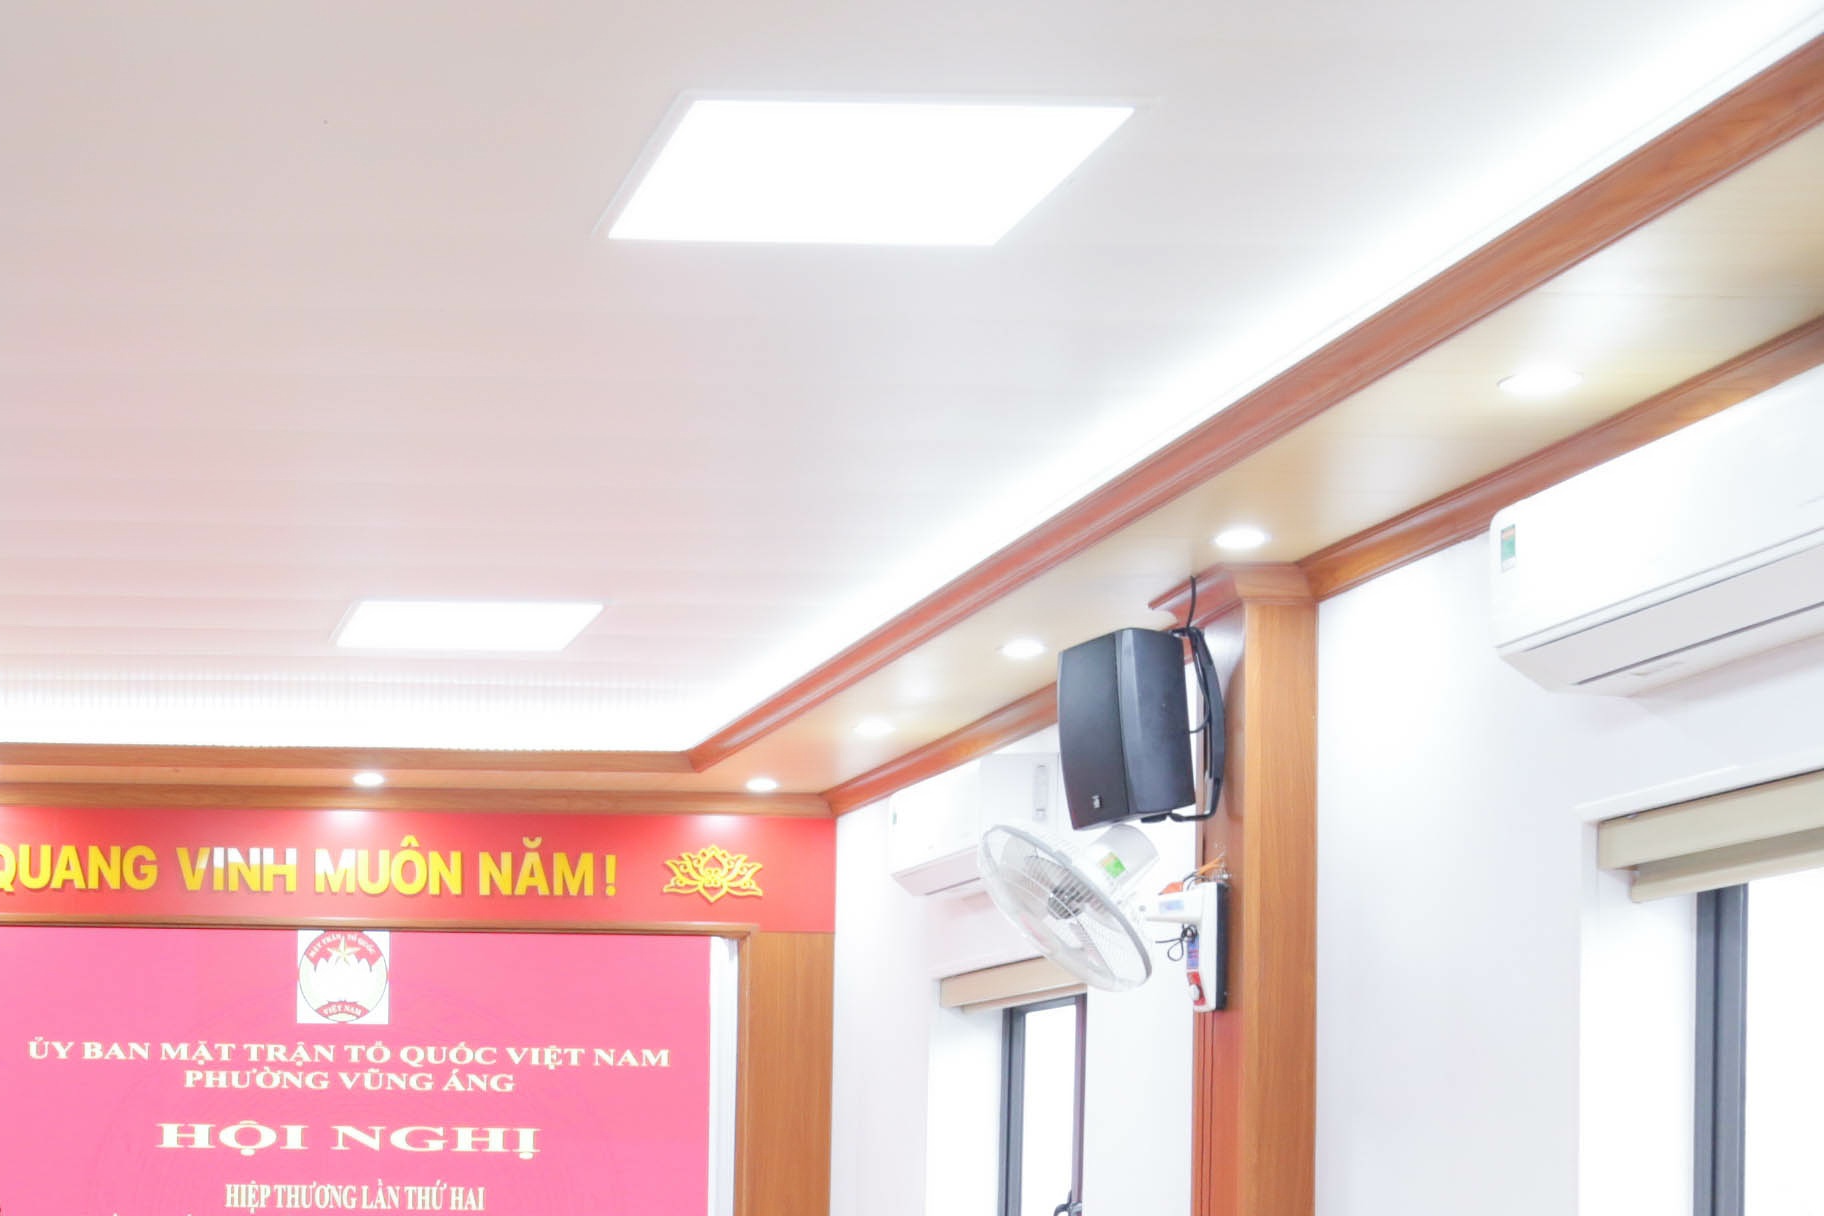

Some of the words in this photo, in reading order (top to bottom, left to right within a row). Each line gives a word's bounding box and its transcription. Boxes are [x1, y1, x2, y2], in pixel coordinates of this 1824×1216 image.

[176, 846, 298, 892] VINH
[314, 835, 462, 895] MUÔN
[29, 1037, 74, 1060] ỦY
[83, 1041, 150, 1060] BAN
[160, 1040, 237, 1066] MẶT
[243, 1041, 336, 1067] TRẬN
[344, 1041, 391, 1064] TỔ
[400, 1041, 497, 1067] QUỐC
[506, 1045, 586, 1070] VIỆT
[594, 1048, 670, 1067] NAM
[184, 1067, 330, 1090] PHƯỜNG
[338, 1068, 434, 1091] VŨNG
[442, 1068, 515, 1092] ÁNG
[155, 1120, 309, 1157] HỘI
[329, 1125, 541, 1160] NGHỊ
[225, 1181, 271, 1213] HIỆP
[274, 1181, 358, 1210] THƯƠNG
[361, 1179, 401, 1210] LẦN
[404, 1179, 448, 1210] THỨ
[450, 1186, 485, 1211] HAI
